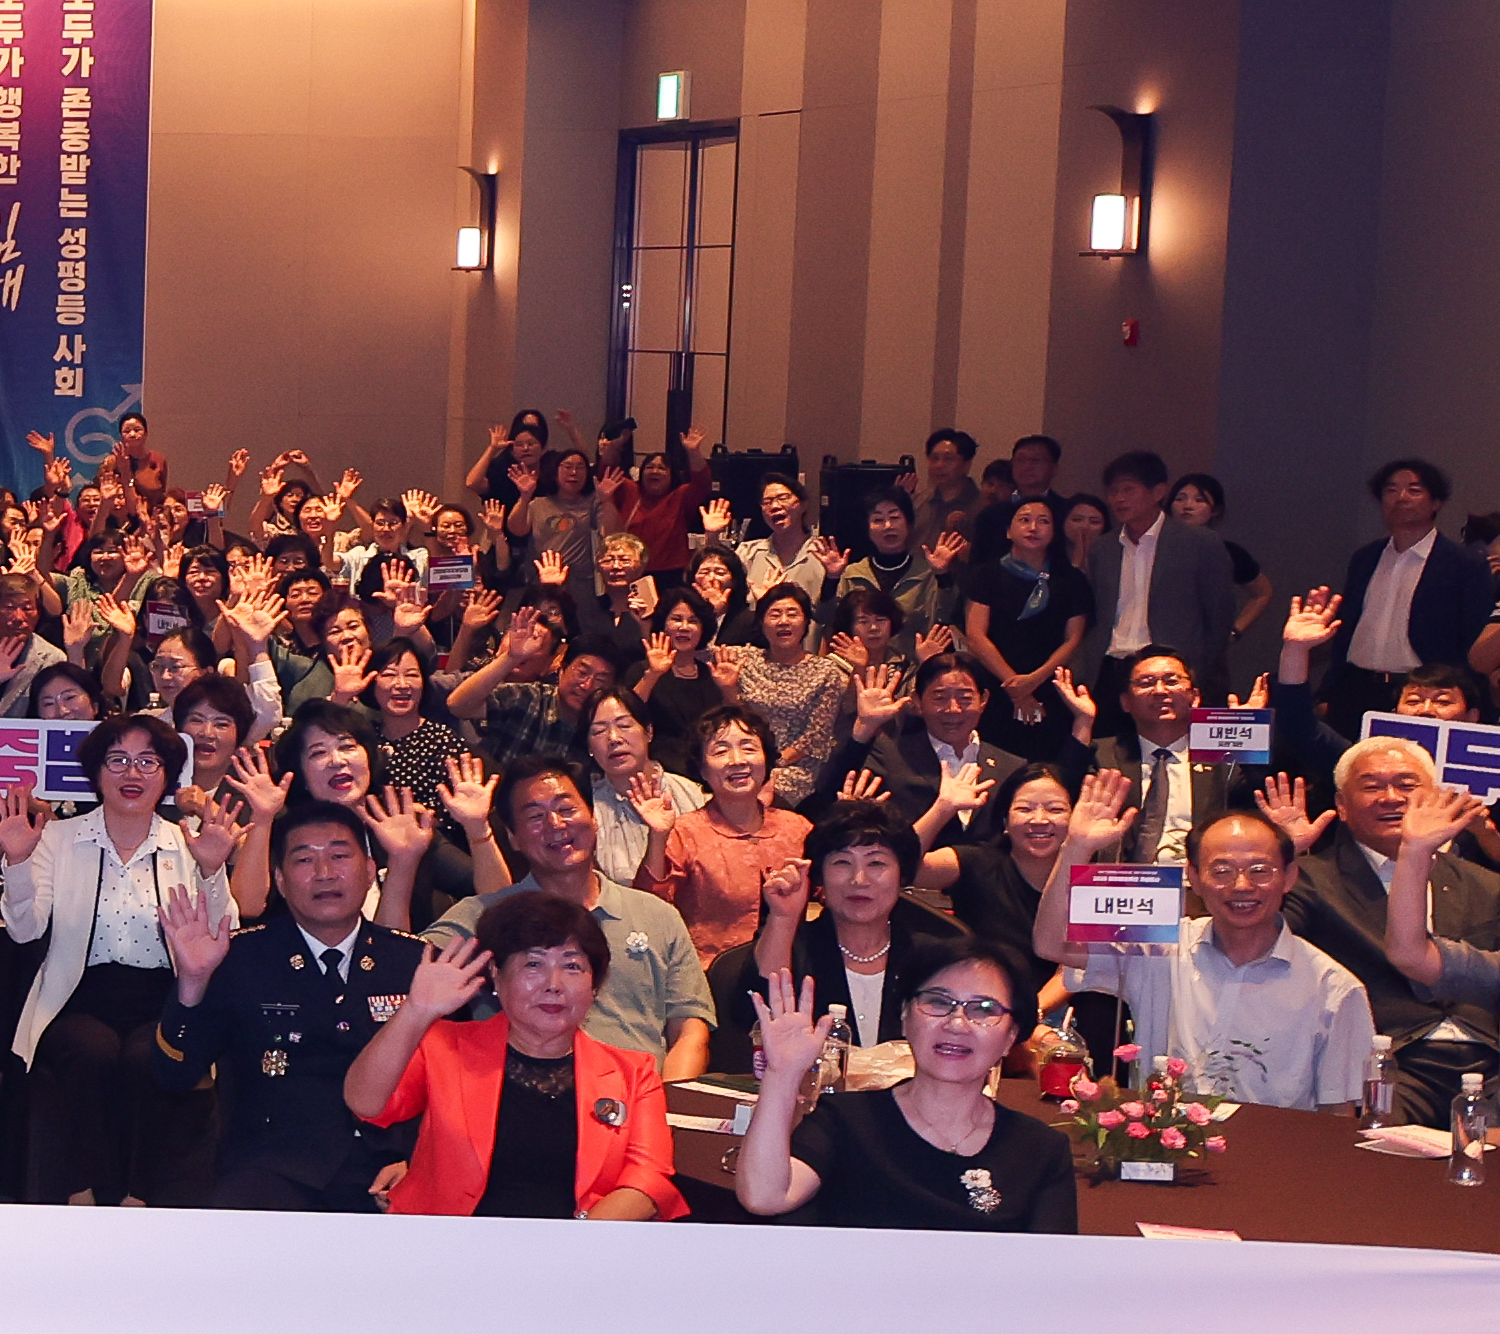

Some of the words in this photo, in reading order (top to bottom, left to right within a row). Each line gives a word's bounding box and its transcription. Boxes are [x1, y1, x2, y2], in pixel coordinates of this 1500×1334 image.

[58, 87, 92, 218] 존중받는
[56, 228, 88, 326] 성평등
[52, 334, 86, 398] 사회
[1209, 727, 1252, 740] 내빈석
[1094, 897, 1154, 915] 내빈석
